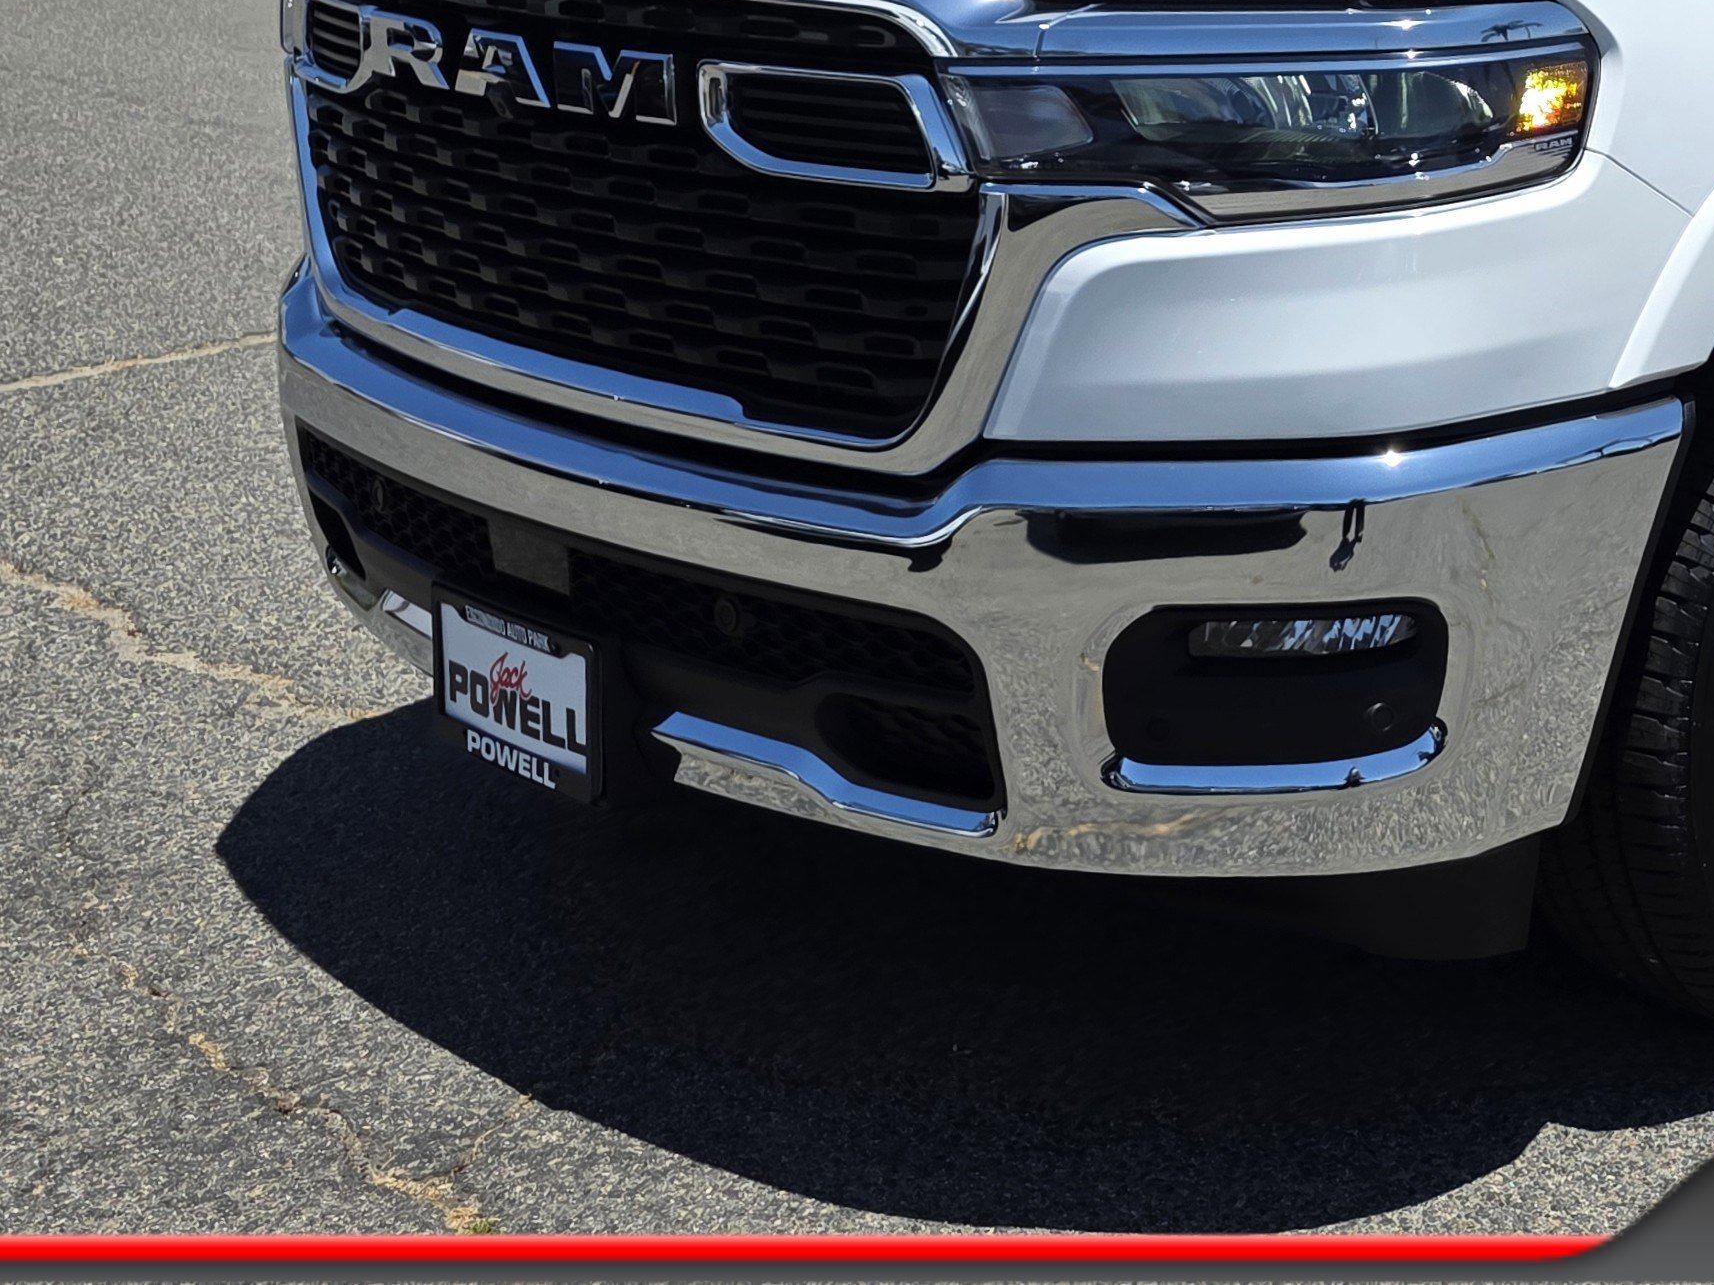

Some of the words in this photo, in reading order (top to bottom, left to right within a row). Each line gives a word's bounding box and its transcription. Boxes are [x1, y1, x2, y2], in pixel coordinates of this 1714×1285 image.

[348, 7, 678, 126] RAM
[1535, 137, 1573, 150] RAM
[448, 659, 587, 755] POWELL
[489, 651, 532, 704] Jack
[466, 728, 556, 790] POWELL
